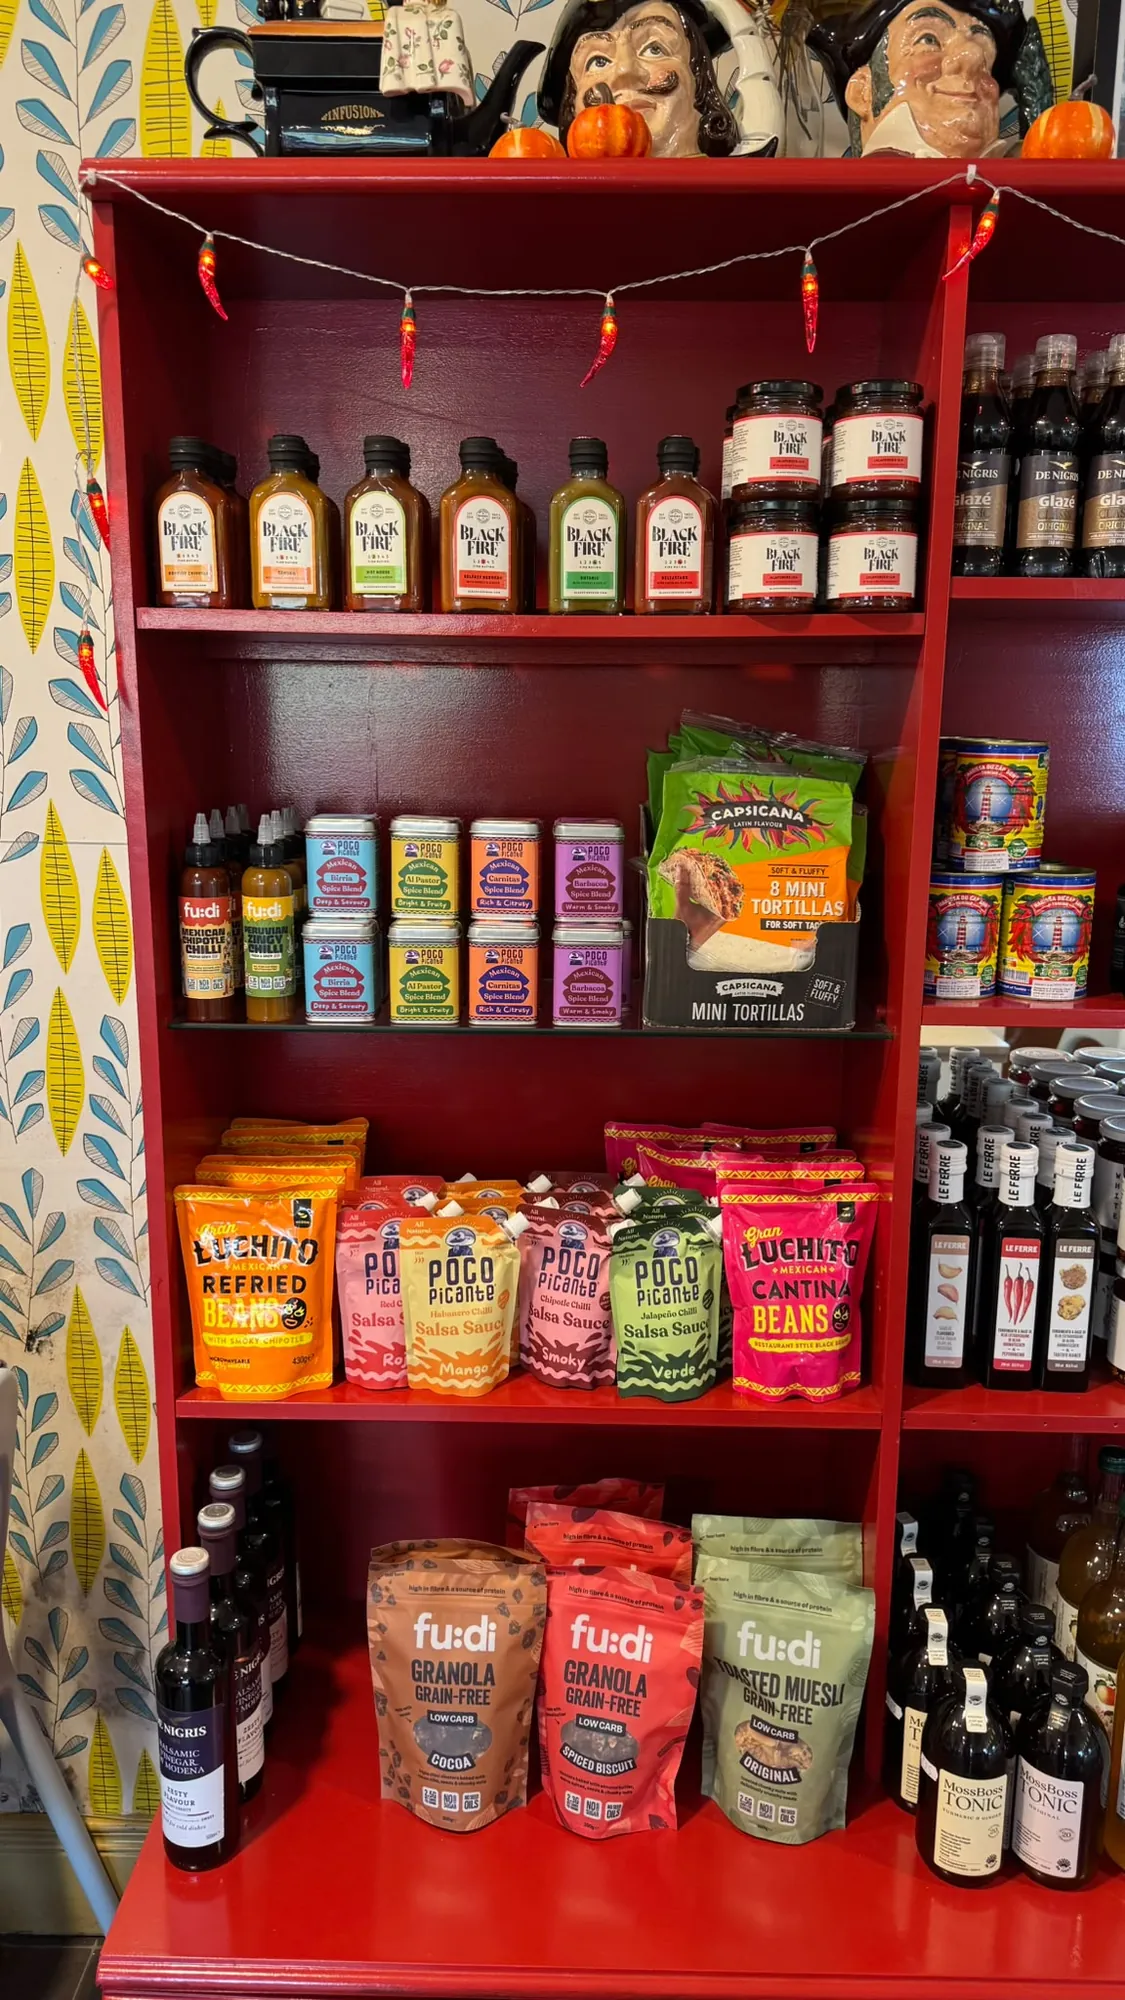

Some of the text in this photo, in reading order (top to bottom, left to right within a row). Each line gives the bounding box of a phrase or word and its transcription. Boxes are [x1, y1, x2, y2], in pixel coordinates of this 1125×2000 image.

[774, 430, 806, 443] BLACK
[779, 442, 802, 455] FIRE
[963, 469, 998, 478] NIGRIS
[1036, 471, 1078, 481] DE NIGRIS
[1039, 495, 1074, 507] Glazé
[164, 520, 208, 536] BLACK
[263, 521, 308, 537] BLACK
[355, 521, 399, 536] BLACK
[461, 524, 505, 541] BLACK
[567, 526, 612, 542] BLACK
[652, 525, 698, 541] BLACK
[171, 536, 201, 551] FIRE
[270, 537, 301, 553] FIRE
[362, 536, 392, 551] FIRE
[467, 541, 498, 557] FIRE
[574, 542, 604, 557] FIRE
[660, 542, 690, 557] FIRE
[711, 804, 804, 822] CAPSICANA
[754, 820, 783, 828] FLAVOUR
[338, 841, 359, 850] POCO
[420, 844, 442, 852] POCO
[502, 843, 523, 851] POCO
[588, 847, 610, 856] POCO
[327, 858, 357, 870] Mexican
[409, 860, 438, 872] Mexican
[490, 860, 520, 871] Mexican
[576, 864, 606, 875] Mexican
[772, 867, 788, 875] SOFT
[799, 867, 825, 875] FLUFFY
[331, 874, 353, 882] Birria
[322, 885, 362, 893] Spice Blend
[403, 887, 421, 895] Spice
[485, 886, 502, 895] Spice
[571, 890, 611, 899] Spice Blend
[770, 881, 825, 897] 8 MINI
[184, 902, 219, 918] fu:di
[247, 902, 281, 917] fu:di
[751, 900, 844, 916] TORTILLAS
[182, 928, 225, 936] MEXICAN
[245, 926, 288, 934] PERUVIAN
[783, 921, 803, 929] SOFT
[183, 936, 225, 944] CHIPOTLE
[248, 934, 282, 945] ZINGY
[186, 945, 221, 954] CHILLI
[248, 945, 283, 953] CHILLI
[722, 982, 777, 993] CAPSICANA
[814, 978, 840, 993] SOFT &
[810, 988, 838, 1003] FLUFFY
[692, 1002, 804, 1021] MINI TORTILLAS
[939, 1155, 950, 1199] LE FERRE
[1009, 1155, 1020, 1200] LE FERRE
[1073, 1158, 1086, 1202] LE FERRE
[744, 1227, 783, 1247] Gran
[193, 1235, 319, 1267] LUCHITO
[741, 1237, 859, 1271] LUCHITO
[232, 1263, 280, 1271] MEXICAN
[541, 1247, 600, 1280] POCO
[780, 1265, 827, 1274] MEXICAN
[429, 1257, 493, 1287] POCO
[635, 1257, 698, 1288] POCO
[203, 1275, 306, 1294] REFRIED
[752, 1280, 851, 1299] CANTINA
[541, 1295, 591, 1310] Chipotle Chilli
[204, 1298, 279, 1329] BEANS
[430, 1307, 492, 1319] Habanero Chilli
[529, 1303, 609, 1329] Salsa Sauce
[641, 1307, 697, 1320] Jalapeño Chilli
[753, 1305, 829, 1334] BEANS
[416, 1322, 459, 1336] Salsa
[624, 1323, 668, 1339] Salsa
[230, 1336, 259, 1345] SMOKY
[755, 1341, 793, 1349] RESTAURANT
[542, 1347, 586, 1368] Smoky
[440, 1363, 488, 1378] Mango
[651, 1362, 695, 1379] Verde
[734, 1590, 745, 1599] high
[754, 1593, 768, 1602] fibre
[780, 1599, 800, 1608] source
[809, 1604, 832, 1613] protein
[414, 1612, 497, 1652] fu:di
[571, 1614, 653, 1663] fu:di
[737, 1620, 822, 1669] fu:di
[411, 1659, 495, 1687] GRANOLA
[564, 1659, 647, 1698] GRANOLA
[714, 1656, 845, 1707] TOASTED MUESLI
[415, 1686, 491, 1706] GRAIN-FREE
[566, 1687, 640, 1717] GRAIN-FREE
[743, 1688, 813, 1726] GRAIN-FREE
[430, 1714, 449, 1722] LOW
[163, 1725, 206, 1738] NIGRIS
[578, 1718, 623, 1734] LOW CARB
[753, 1719, 795, 1740] LOW CARB
[431, 1754, 471, 1770] COCOA
[562, 1746, 633, 1774] SPICED BISCUIT
[165, 1762, 204, 1774] MODENA
[744, 1756, 797, 1782] ORIGINAL
[944, 1779, 1003, 1796] MossBoss
[1021, 1766, 1077, 1798] MossBoss
[164, 1792, 195, 1806] FLAVOUR
[167, 1786, 188, 1798] ZESTY
[1021, 1776, 1077, 1814] TONIC
[944, 1789, 1002, 1813] TONIC
